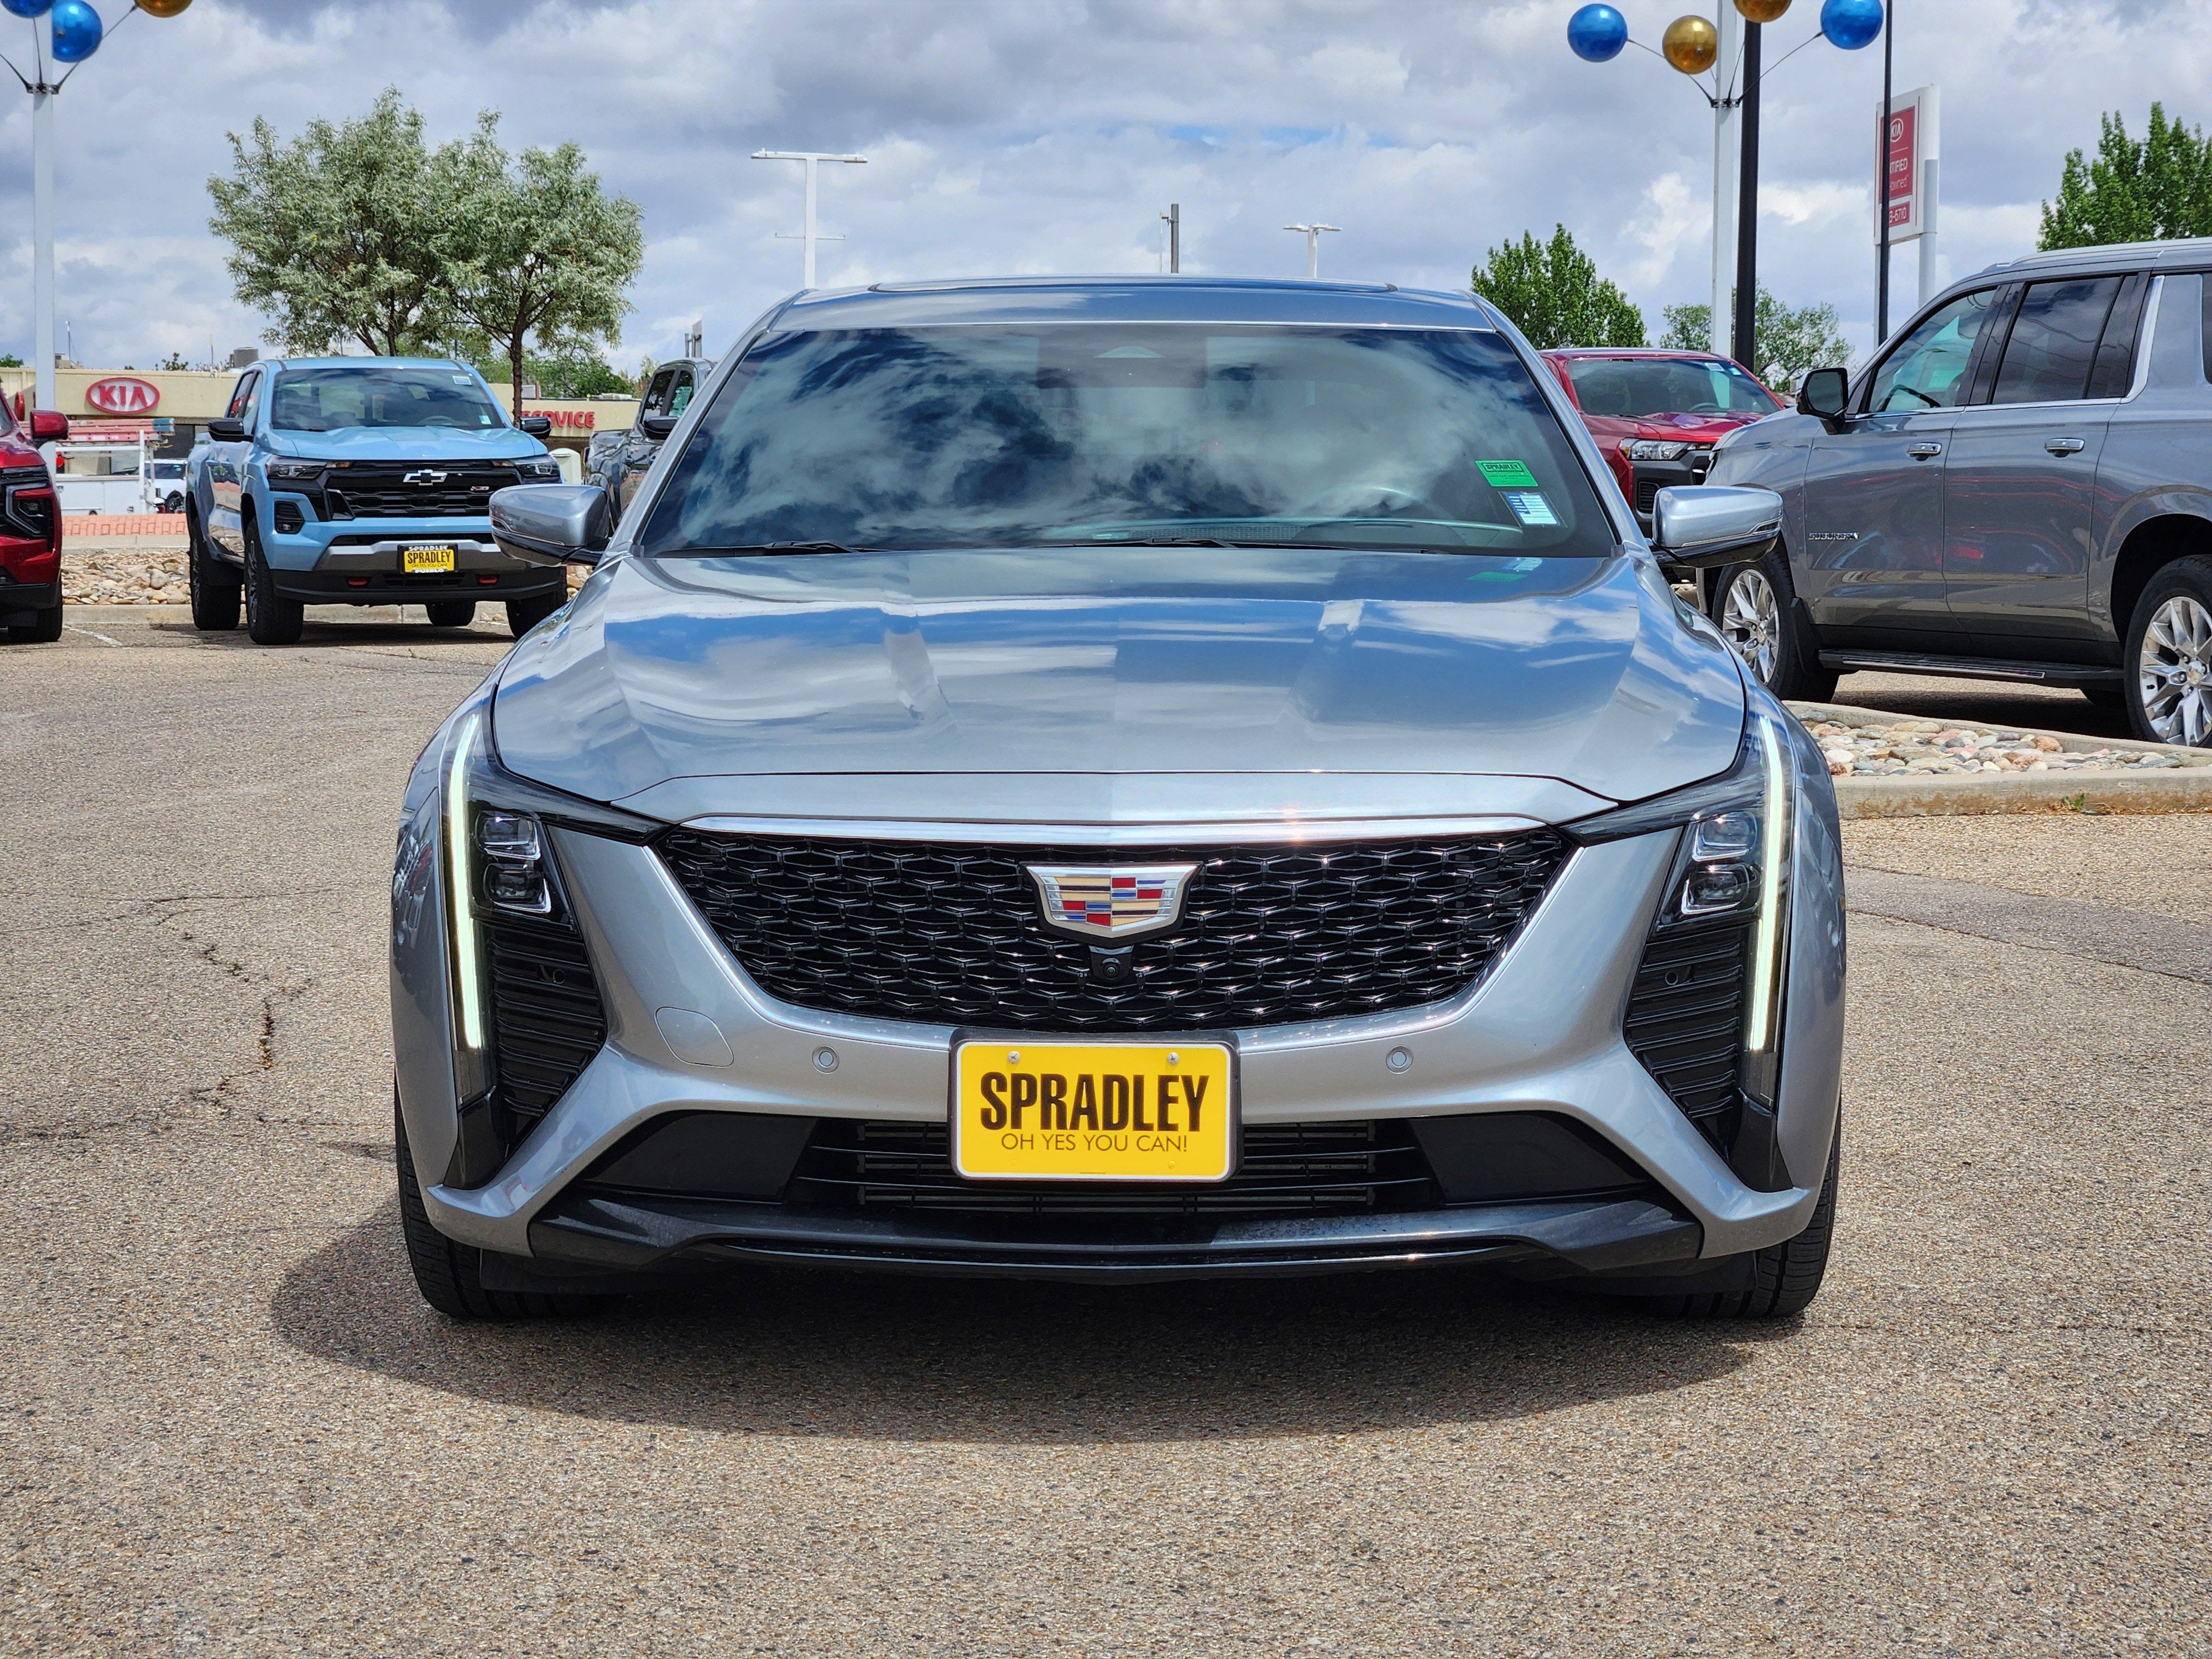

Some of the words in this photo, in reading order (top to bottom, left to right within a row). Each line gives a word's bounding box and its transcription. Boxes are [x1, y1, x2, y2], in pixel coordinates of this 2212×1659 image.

[1890, 122, 1901, 138] KIA
[1889, 158, 1908, 174] RTIFIED
[98, 385, 148, 407] KIA
[408, 551, 451, 564] SPRADLEY
[980, 1071, 1210, 1133] SPRADLEY
[1001, 1133, 1034, 1150] OH
[1042, 1133, 1076, 1151] YES
[1085, 1134, 1129, 1151] YOU
[1136, 1135, 1187, 1152] CAN!
